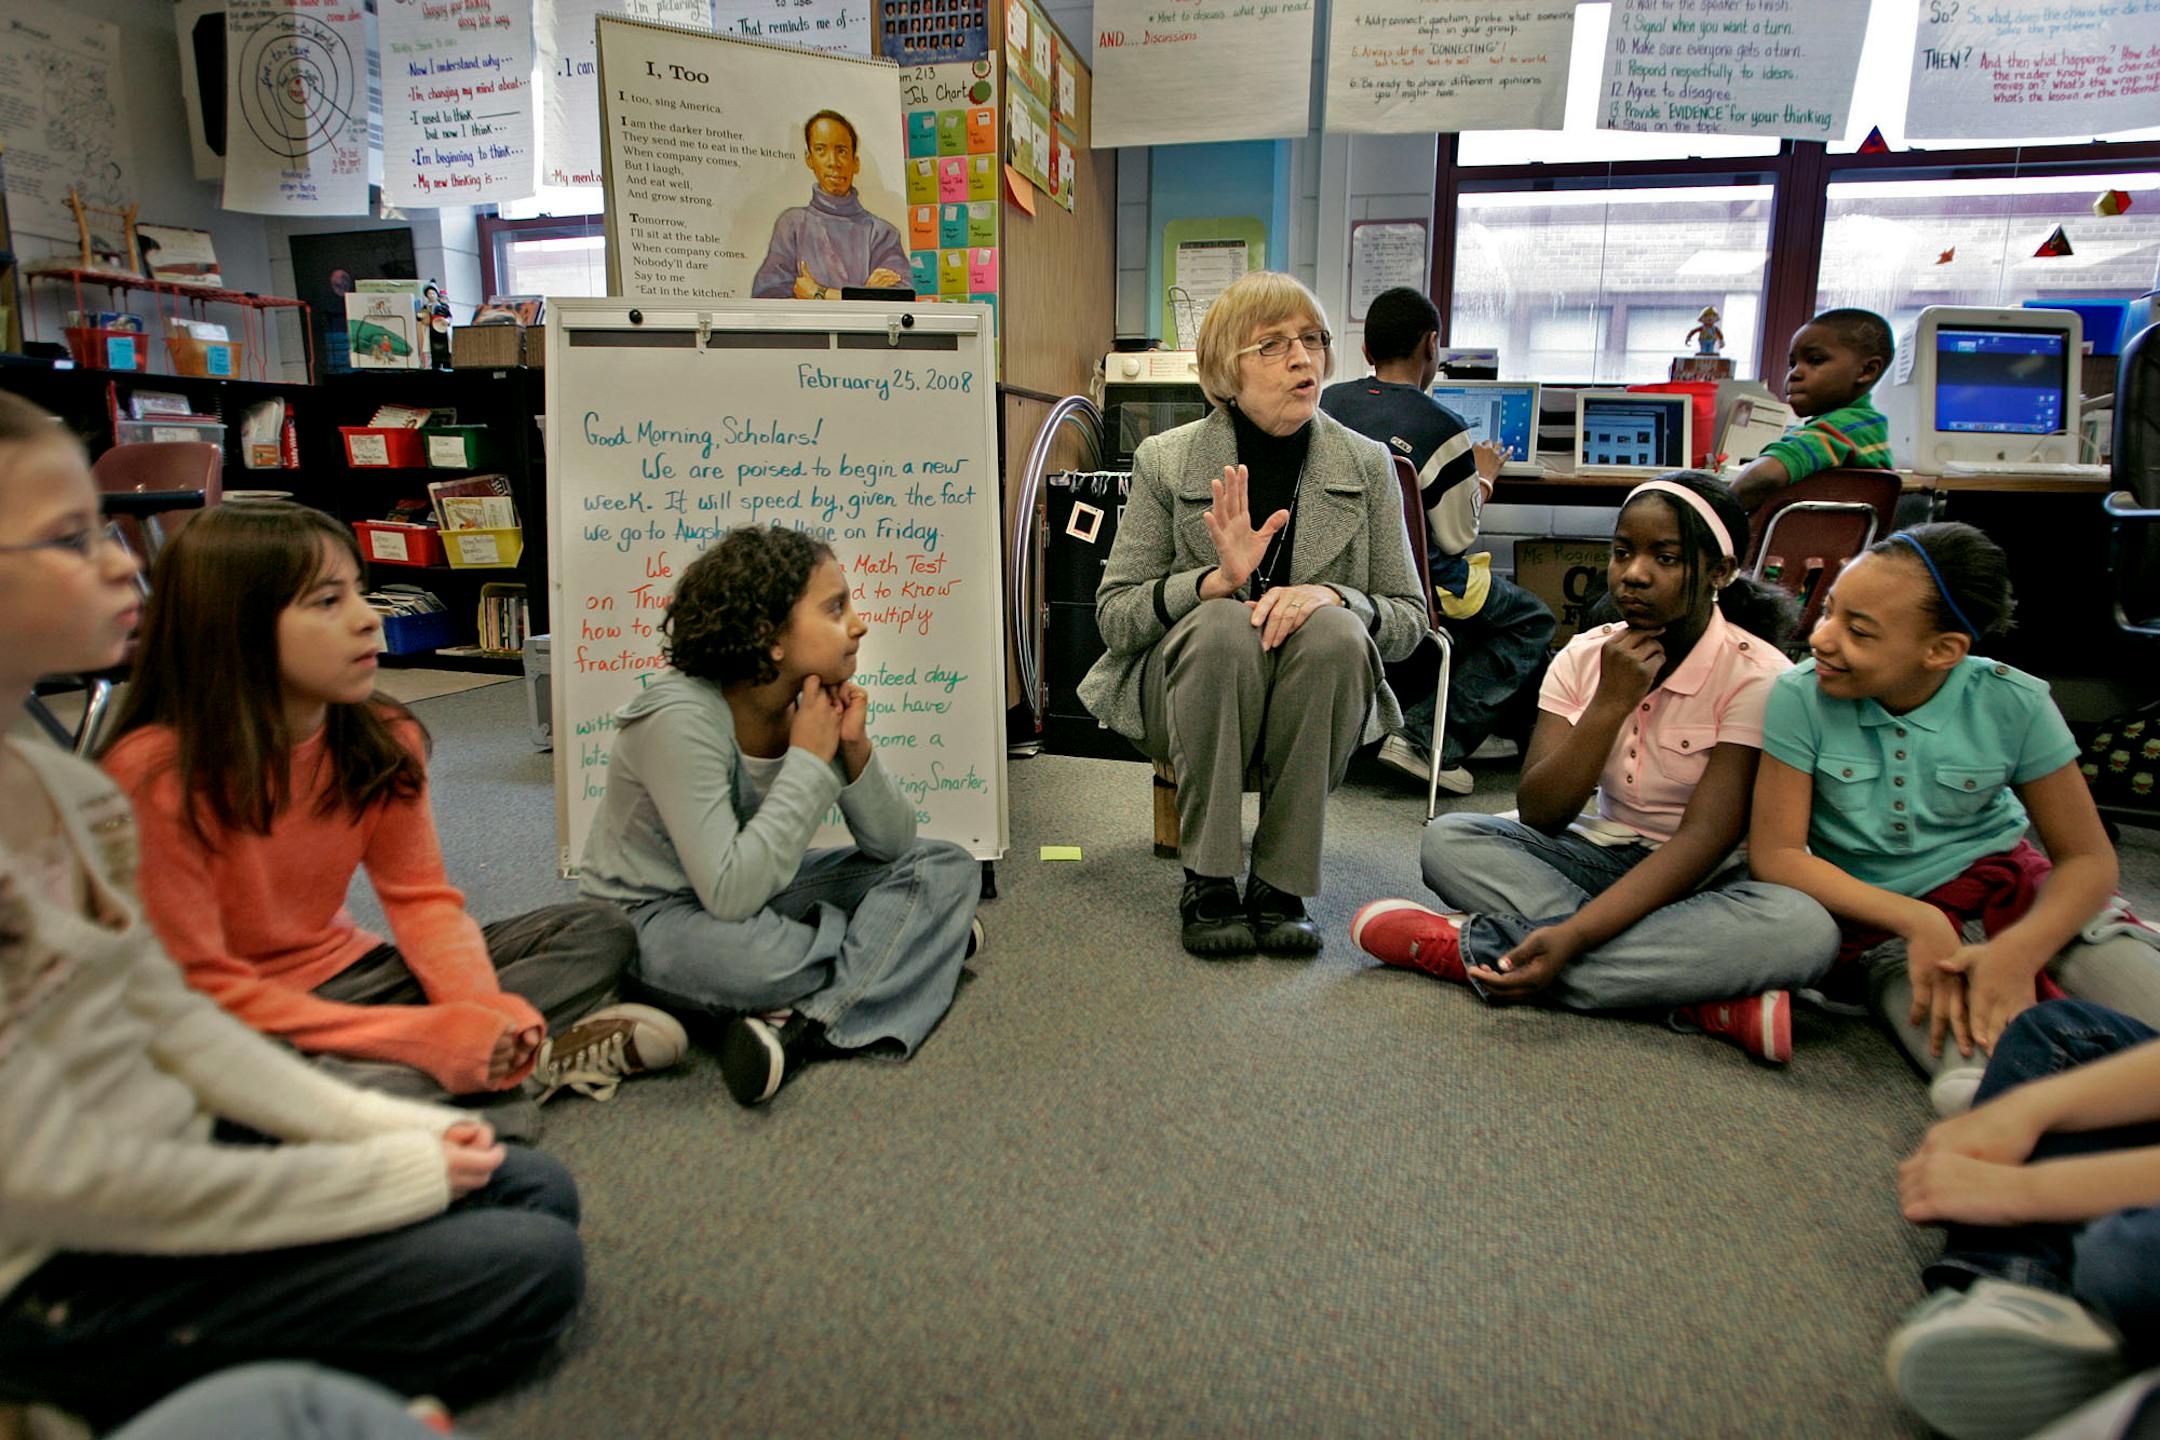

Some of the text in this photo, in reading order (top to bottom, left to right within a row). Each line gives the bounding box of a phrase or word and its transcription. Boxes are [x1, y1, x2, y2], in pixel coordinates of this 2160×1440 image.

[738, 16, 830, 35] That reminds me
[1633, 14, 1748, 43] Signal when you want
[1144, 31, 1198, 45] Discussions
[1632, 38, 1759, 60] Make sure everyone gets
[1923, 46, 2057, 70] THEN? And then what
[437, 56, 479, 72] understand
[577, 62, 595, 75] can
[916, 67, 936, 80] 213
[1628, 59, 1753, 84] Respond respectfully to
[1993, 63, 2113, 81] the reader the
[669, 65, 710, 84] Too
[2089, 75, 2106, 87] the
[428, 87, 459, 103] changing
[477, 80, 494, 93] mind
[905, 80, 969, 105] Job Chart
[1627, 80, 1675, 102] Agree to
[655, 98, 677, 109] sing
[423, 107, 473, 124] used to think
[1625, 104, 1661, 120] Provide
[1730, 107, 1746, 121] for
[1751, 109, 1779, 126] your
[425, 128, 438, 140] but
[621, 116, 627, 126] I
[630, 121, 646, 129] am
[650, 120, 666, 131] the
[669, 123, 702, 135] darker
[1622, 119, 1690, 132] Stay on the
[622, 131, 796, 160] They send me to eat in the kitchen
[435, 147, 474, 168] beginning
[478, 146, 487, 160] to
[623, 146, 653, 157] When
[656, 151, 702, 165] company
[625, 160, 642, 170] But
[646, 161, 650, 171] I
[418, 174, 481, 193] My new thinking
[627, 175, 647, 185] And
[650, 179, 666, 187] eat
[628, 189, 648, 199] And
[651, 192, 676, 203] grow
[646, 229, 659, 239] sit
[663, 231, 673, 240] at
[675, 232, 692, 242] the
[695, 233, 720, 243] table
[631, 242, 662, 253] When
[664, 247, 711, 260] company
[633, 256, 708, 270] Nobody'll dare
[634, 271, 685, 282] Say to me
[660, 286, 670, 295] in
[673, 286, 689, 297] the
[798, 363, 890, 400] February
[926, 368, 973, 394] 2008
[584, 411, 632, 447] Good
[722, 416, 824, 446] Scholars!
[642, 452, 970, 488] We are poised to begin a new
[664, 490, 687, 514] It
[698, 490, 731, 510] will
[740, 489, 803, 522] speed
[846, 491, 898, 519] given
[904, 482, 936, 506] the
[940, 482, 976, 506] fact
[617, 527, 642, 552] go
[648, 520, 666, 540] to
[844, 527, 866, 540] on
[646, 551, 948, 578] We Math Test
[586, 596, 614, 610] on
[874, 581, 891, 599] to
[582, 618, 622, 640] how
[632, 617, 653, 638] to
[924, 664, 968, 694] day
[864, 702, 896, 725] you
[902, 692, 952, 714] have
[580, 733, 944, 769] lots a
[929, 760, 988, 794] Smarter,
